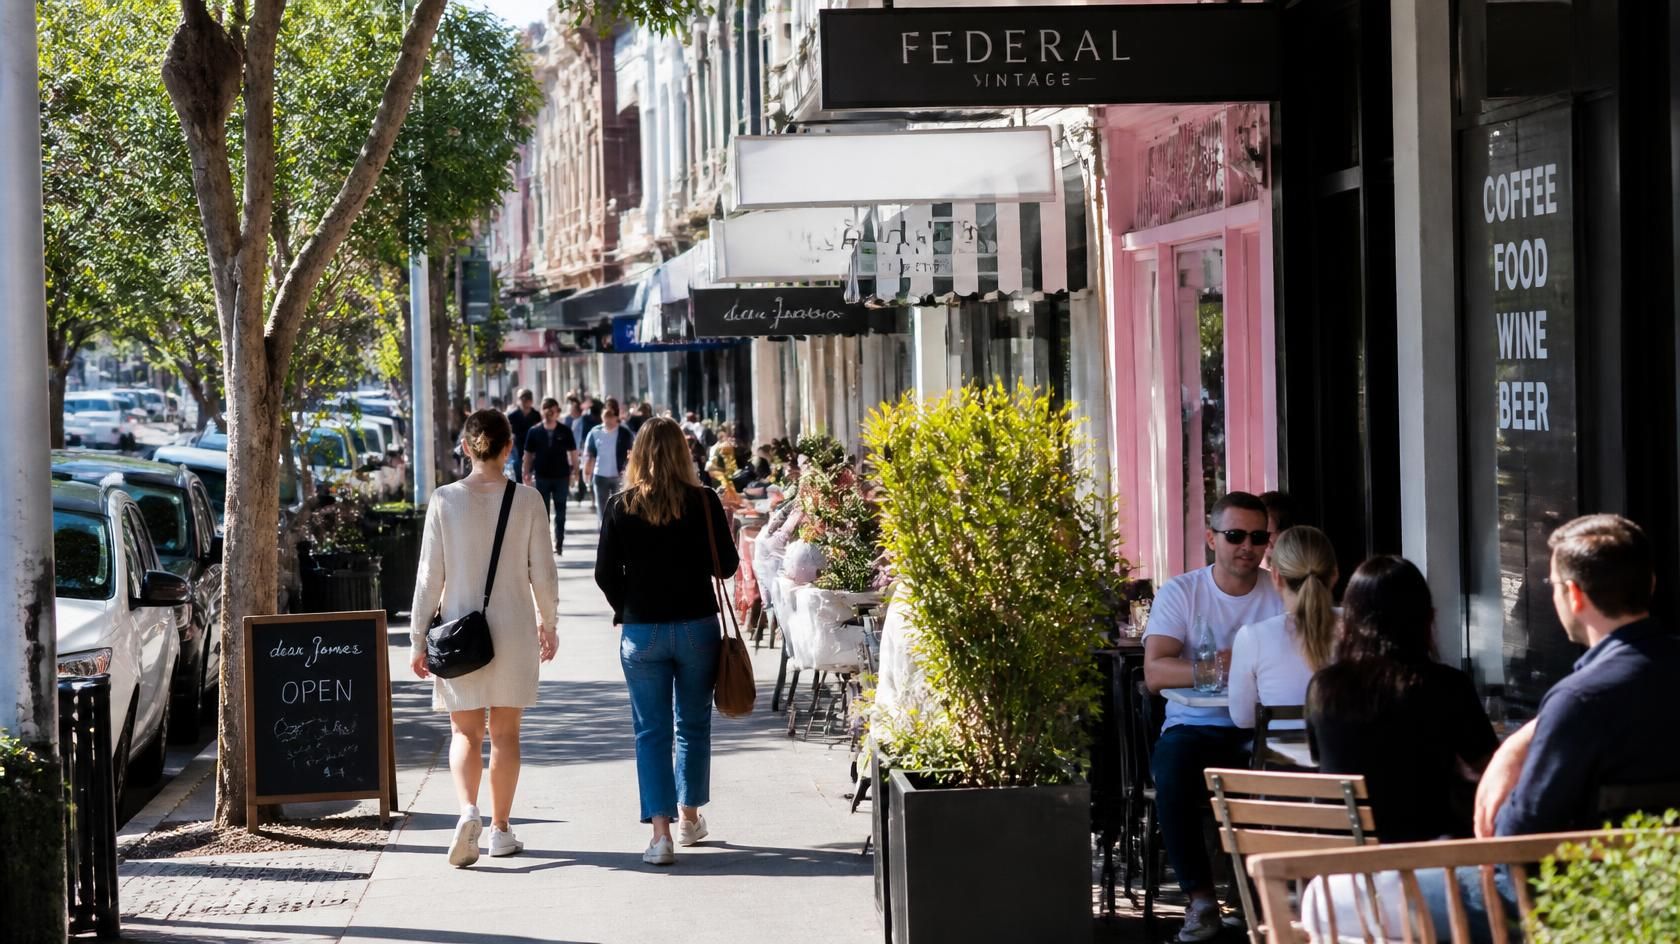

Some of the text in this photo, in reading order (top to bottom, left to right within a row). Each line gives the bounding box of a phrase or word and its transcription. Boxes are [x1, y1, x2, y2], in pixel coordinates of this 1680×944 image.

[901, 29, 1131, 64] FEDERAL
[1483, 163, 1557, 224] COFFEE
[1493, 237, 1548, 292] FOOD
[1496, 310, 1548, 360] WINE
[1498, 381, 1550, 432] BEER
[281, 679, 353, 704] OPEN
